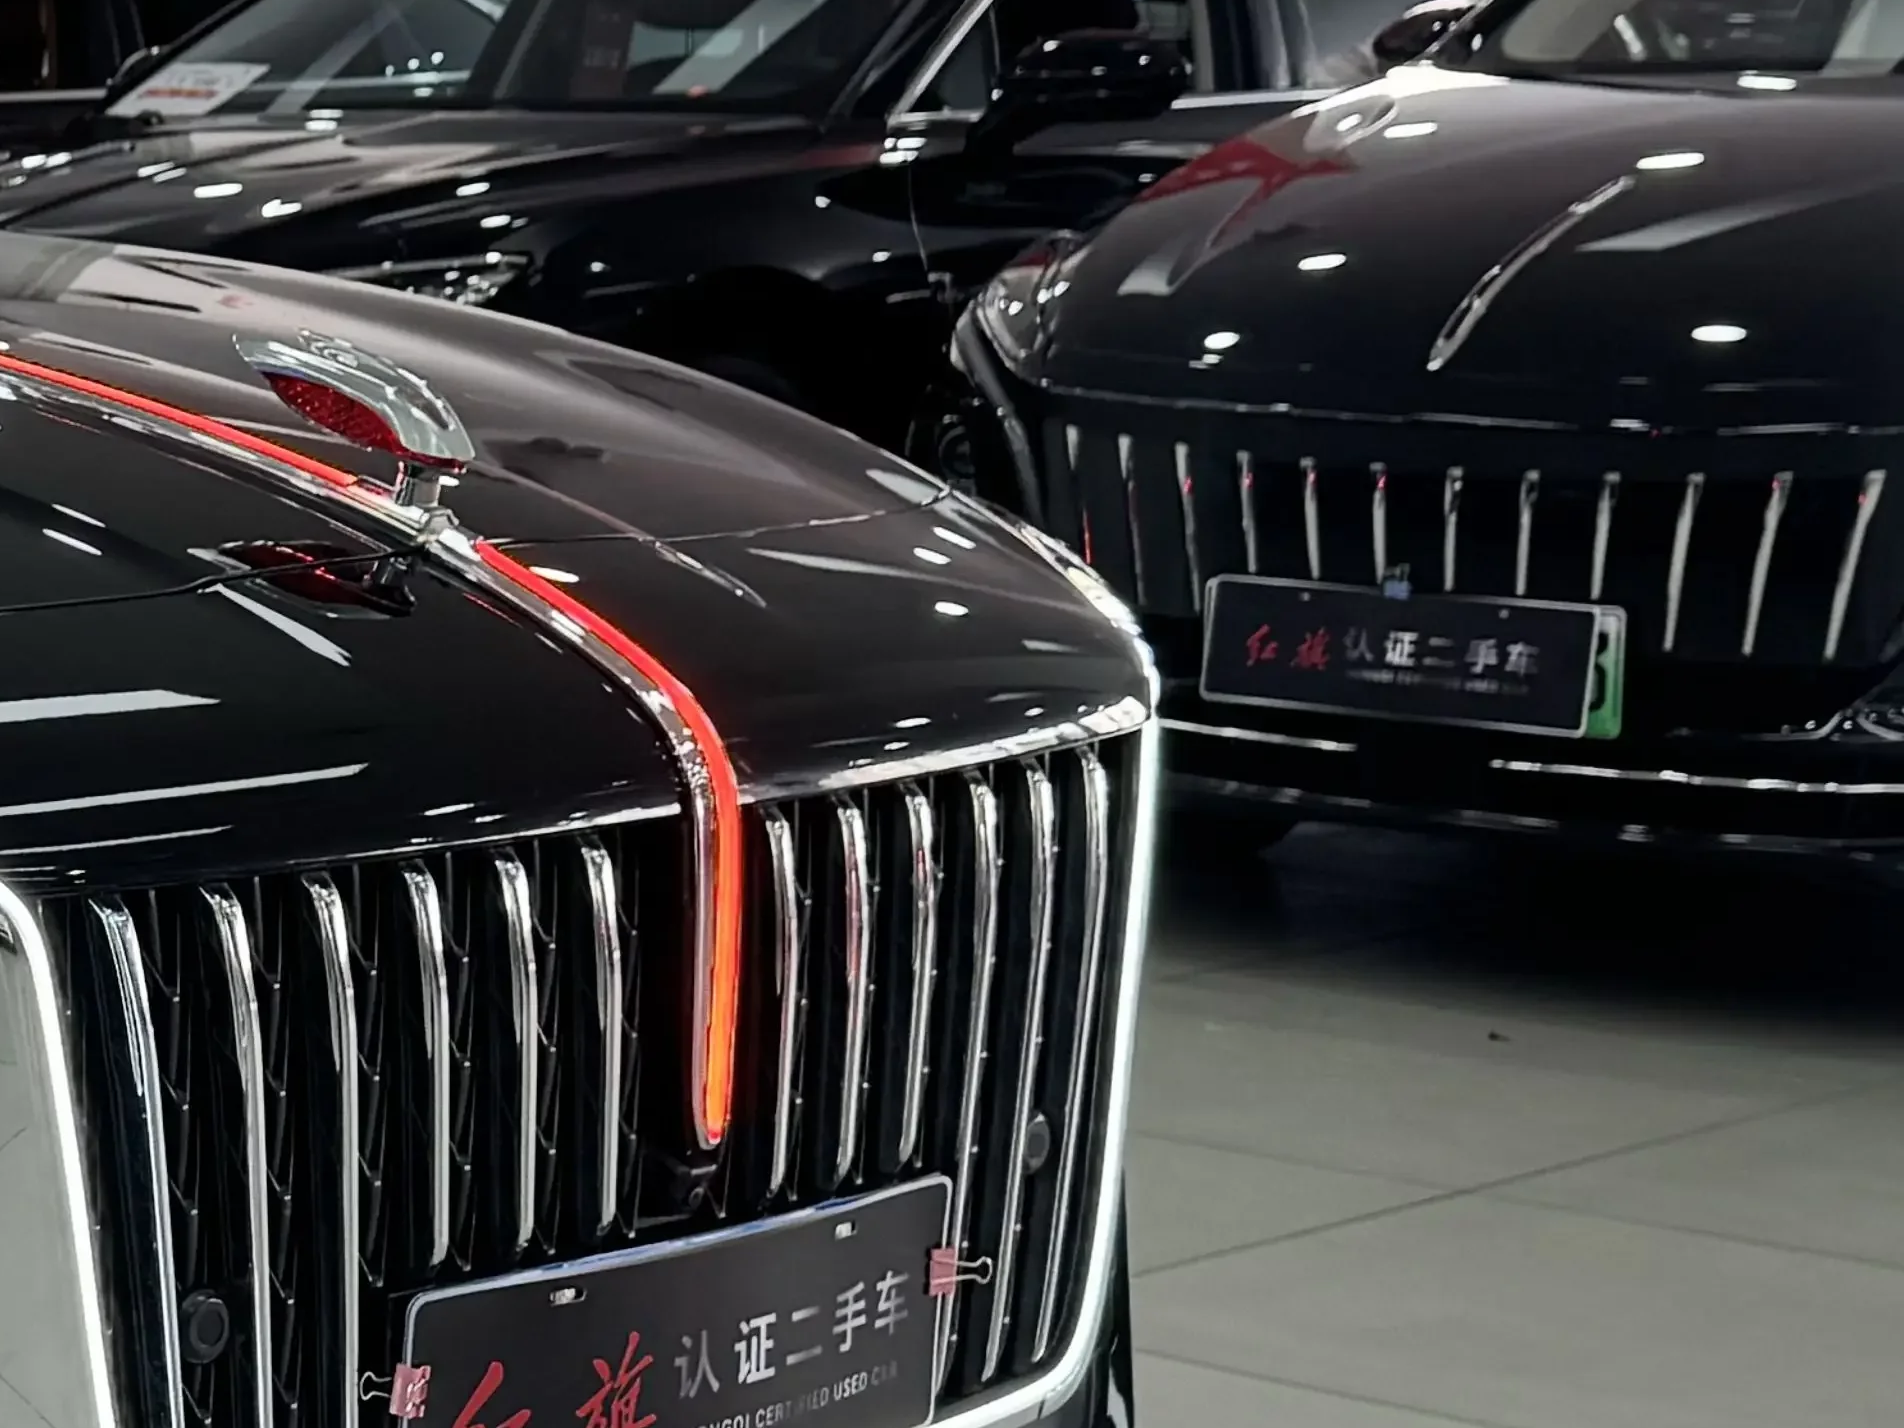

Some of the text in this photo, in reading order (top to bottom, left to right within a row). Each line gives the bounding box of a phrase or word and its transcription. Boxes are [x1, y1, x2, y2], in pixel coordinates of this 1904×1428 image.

[1245, 623, 1331, 671] 红旗
[1342, 626, 1541, 678] 认证二手车
[672, 1269, 911, 1401] 认证二手车
[754, 1386, 830, 1428] CERTFIED
[833, 1371, 868, 1402] USED
